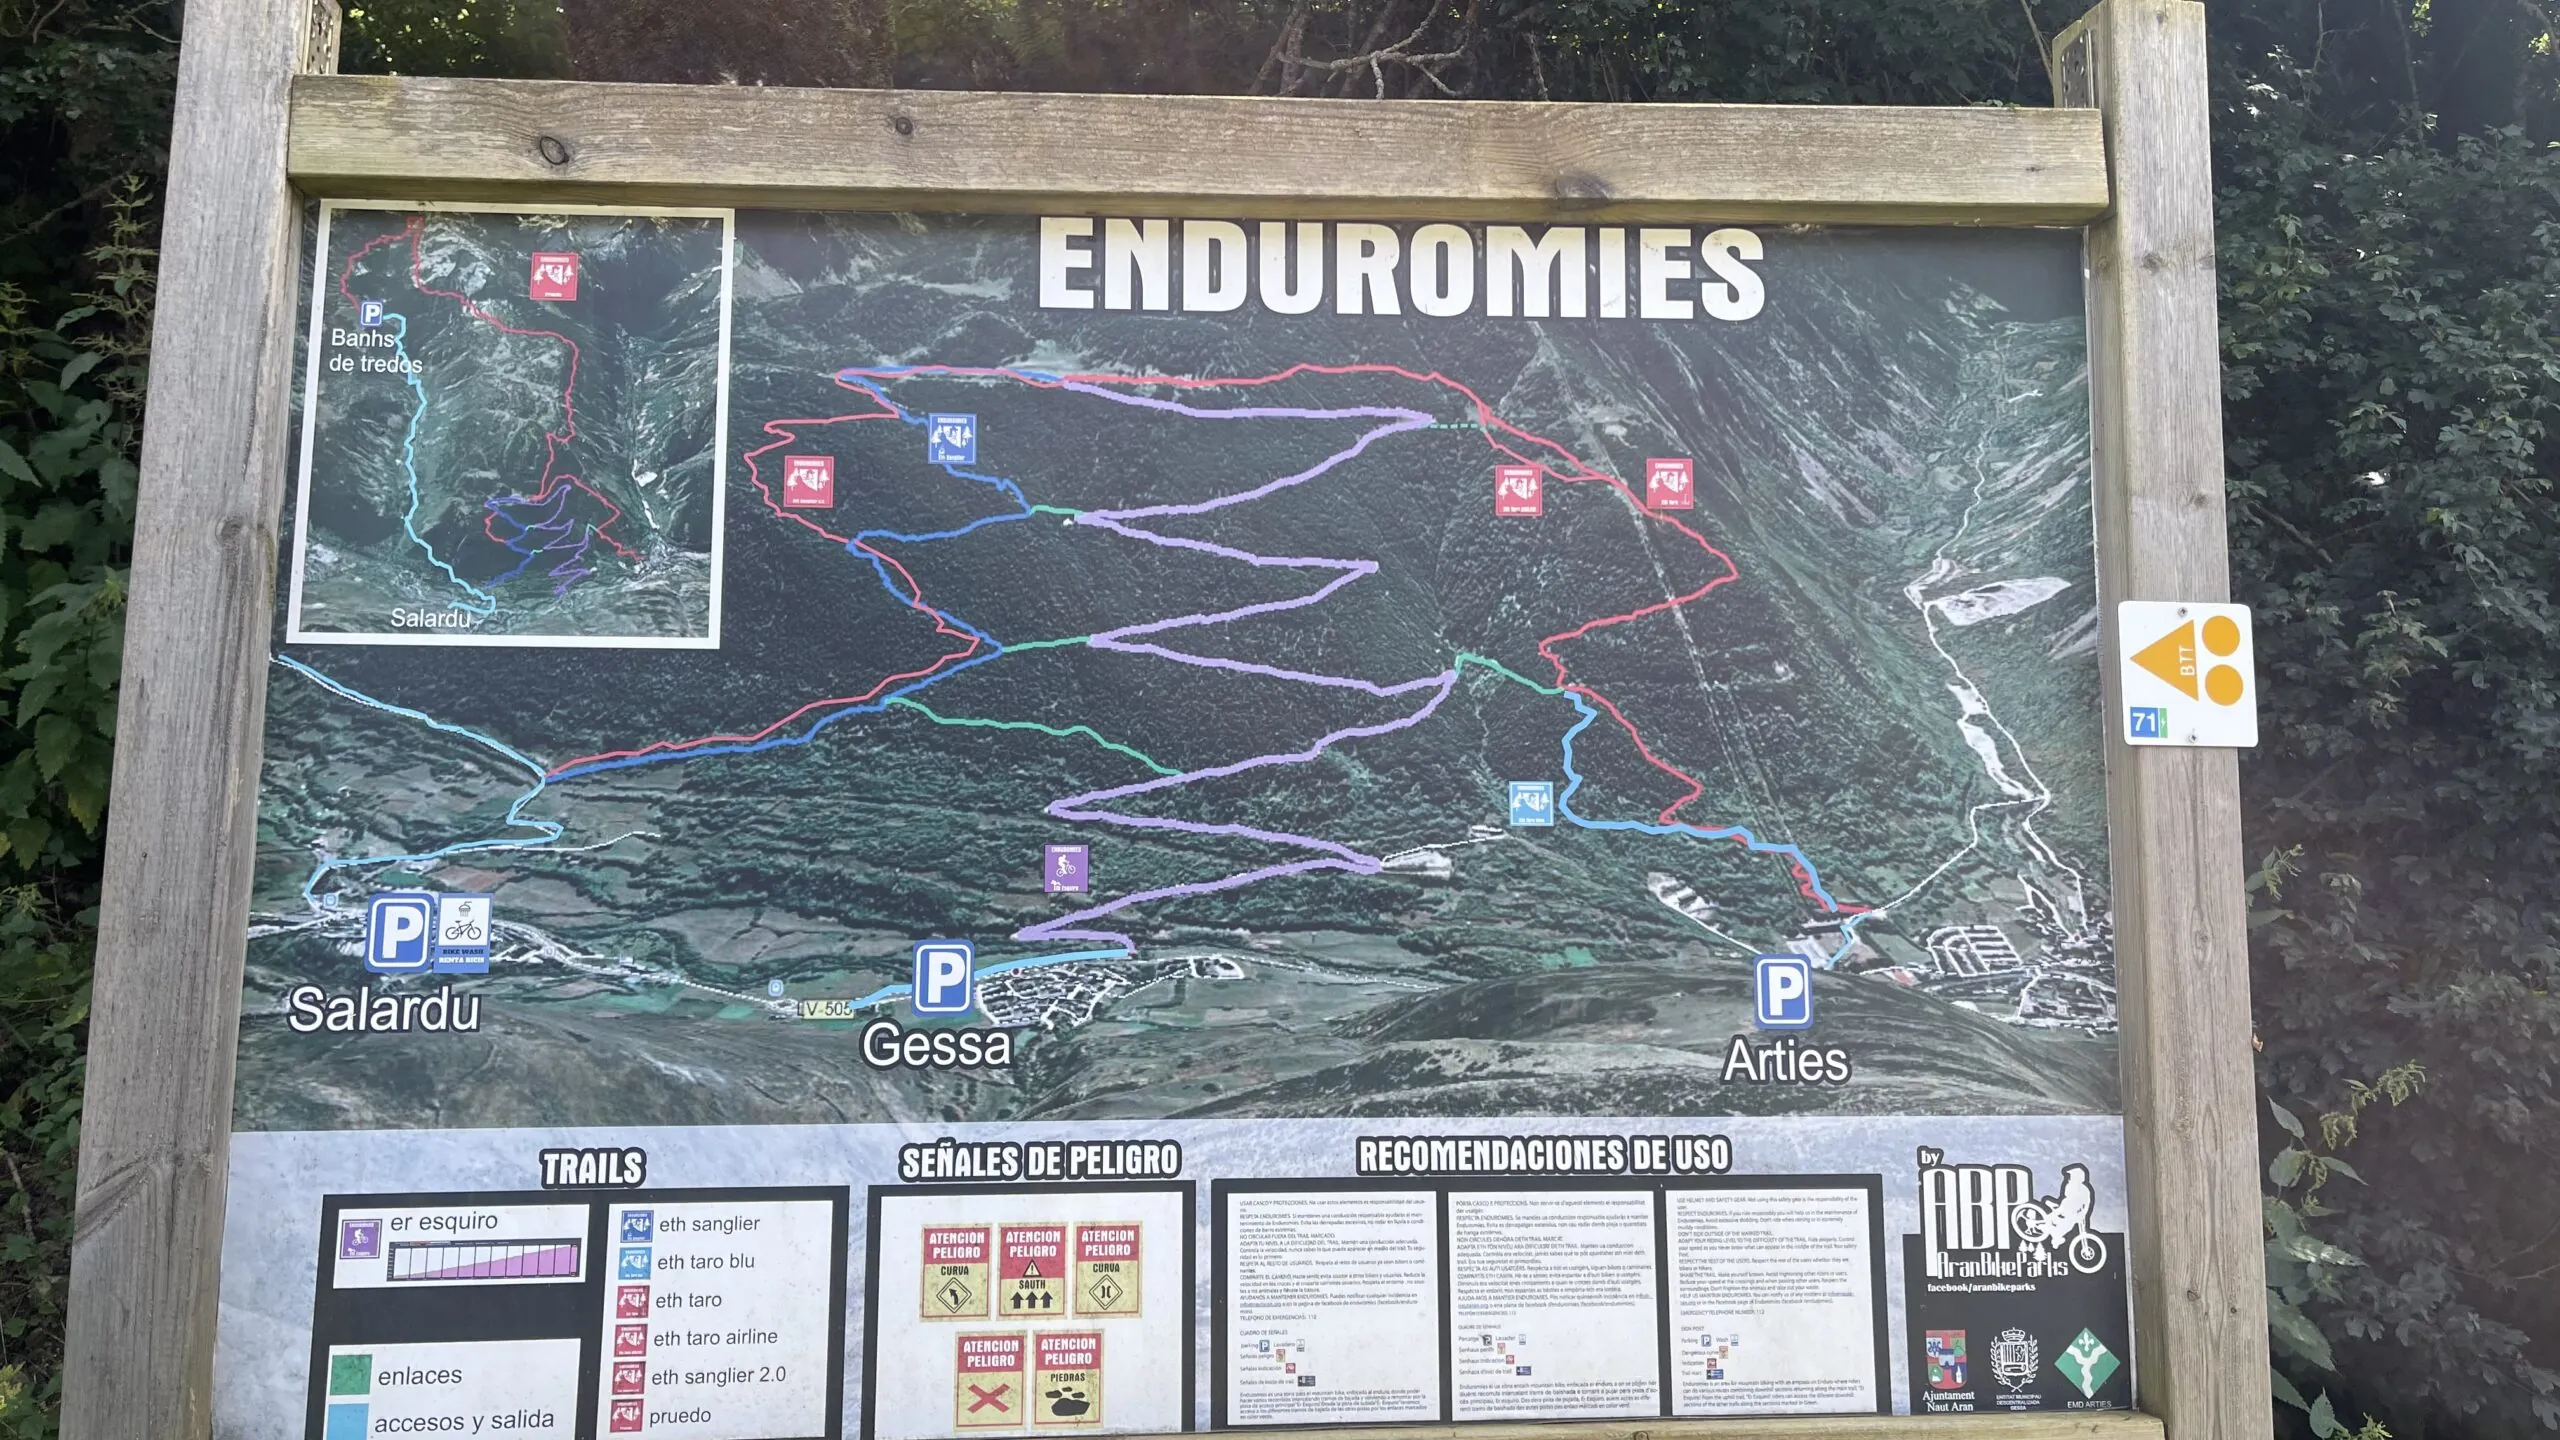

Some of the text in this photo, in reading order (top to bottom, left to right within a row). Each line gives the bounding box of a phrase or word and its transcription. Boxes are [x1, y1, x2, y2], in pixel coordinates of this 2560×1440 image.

[1039, 216, 1765, 321] ENDUROMIES
[332, 330, 394, 348] Banhs
[329, 354, 423, 374] de tredos
[391, 608, 470, 628] Salardu
[2179, 645, 2195, 676] BTT
[2132, 713, 2156, 732] 71
[290, 986, 480, 1032] Salardu
[863, 1022, 1010, 1066] Gessa
[1724, 1038, 1848, 1081] Arties
[902, 1143, 1178, 1178] SEÑALES DE PELIGRO
[1360, 1139, 1728, 1172] RECOMENDACIONES DE USO
[1922, 1150, 1940, 1166] by
[543, 1152, 642, 1185] TRAILS
[390, 1212, 498, 1234] er esquiro
[660, 1216, 760, 1234] eth sanglier
[1923, 1168, 2029, 1276] ABP
[930, 1232, 984, 1244] ATENCION
[1006, 1231, 1060, 1243] ATENCION
[1082, 1230, 1134, 1242] ATENCION
[933, 1247, 980, 1259] PELIGRO
[1010, 1245, 1057, 1258] PELIGRO
[1085, 1244, 1130, 1256] PELIGRO
[658, 1253, 755, 1270] eth taro blu
[1093, 1263, 1120, 1273] CURVA
[941, 1266, 969, 1275] CURVA
[1019, 1280, 1046, 1289] SAUTH
[1928, 1283, 2036, 1293] facebook/aranbikeparks
[656, 1293, 722, 1308] eth taro
[654, 1328, 778, 1346] eth taro airline
[1041, 1338, 1096, 1351] ATENCION
[964, 1340, 1019, 1353] ATENCION
[968, 1355, 1014, 1367] PELIGRO
[1045, 1353, 1092, 1365] PELIGRO
[378, 1366, 462, 1386] enlaces
[652, 1366, 786, 1388] eth sanglier 2.0
[1050, 1373, 1085, 1382] PIEDRAS
[1923, 1391, 1975, 1402] Ajuntament
[1928, 1402, 1974, 1412] Naut Aran
[375, 1409, 554, 1434] accesos y salida
[650, 1407, 712, 1428] pruedo
